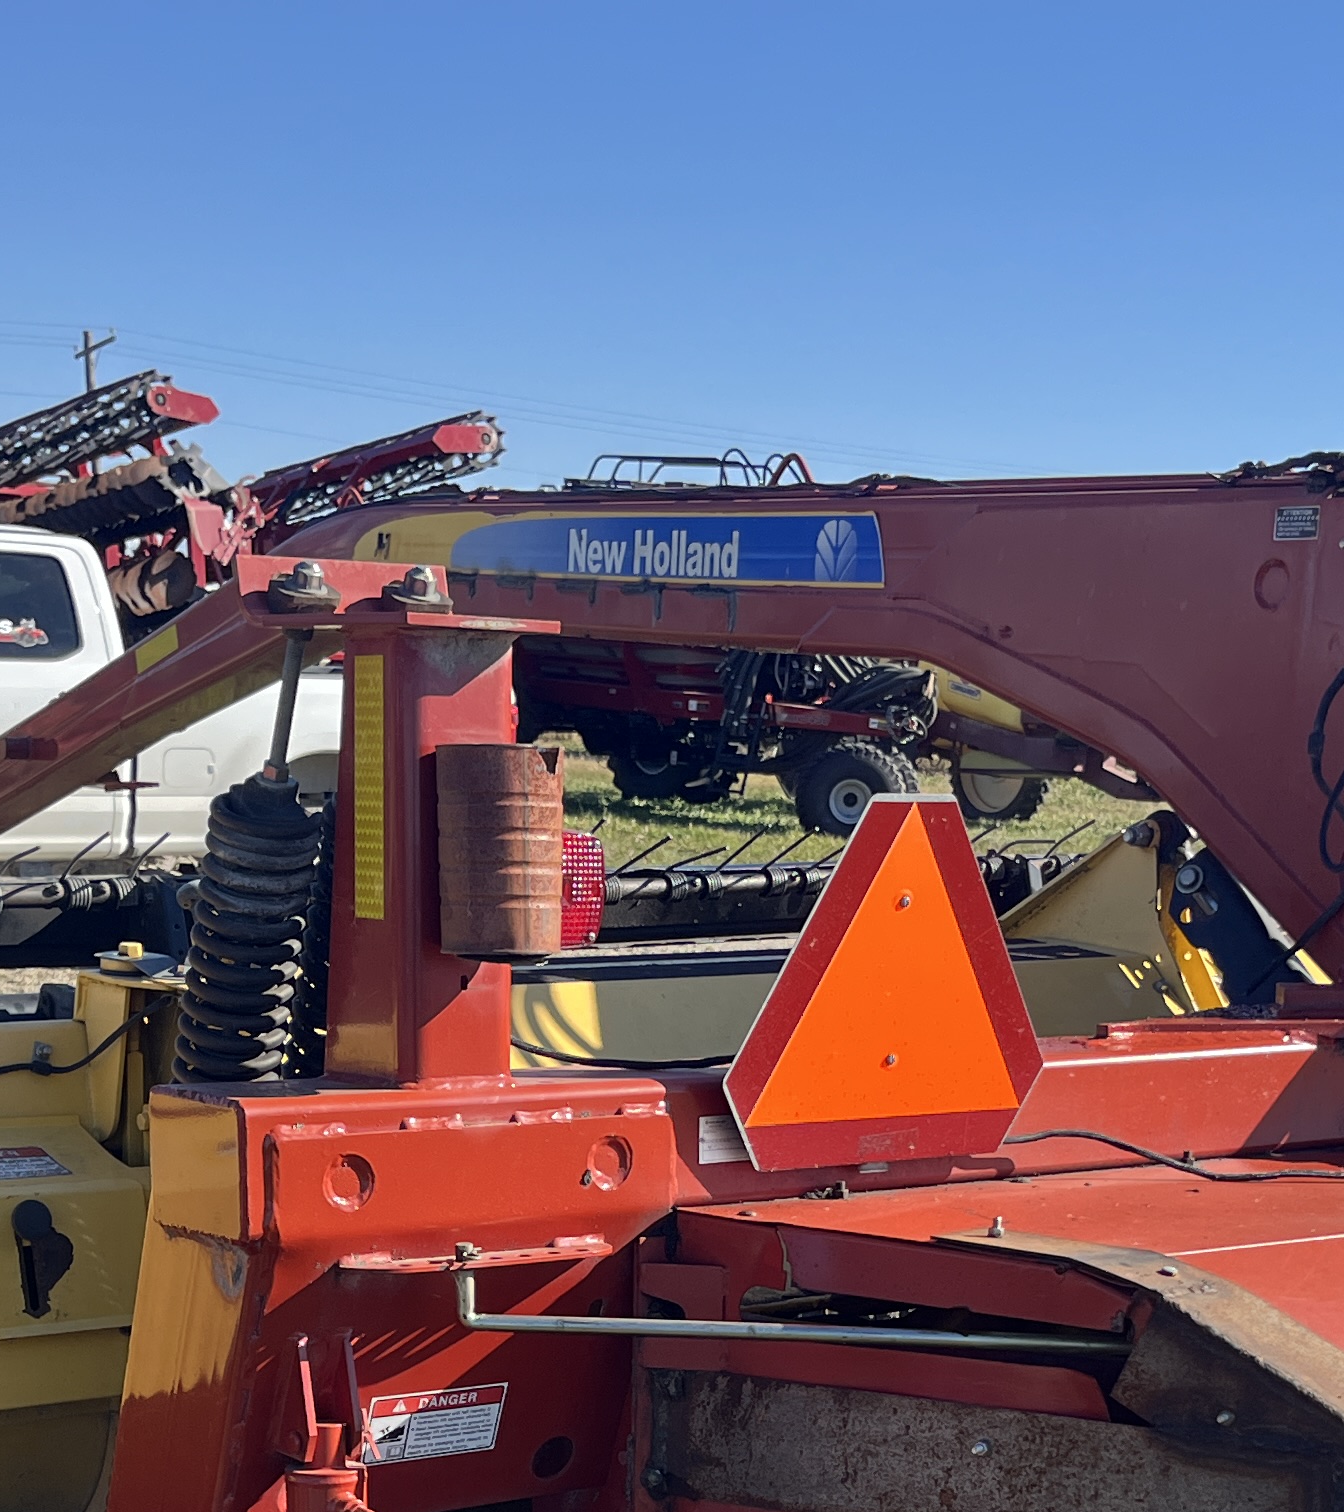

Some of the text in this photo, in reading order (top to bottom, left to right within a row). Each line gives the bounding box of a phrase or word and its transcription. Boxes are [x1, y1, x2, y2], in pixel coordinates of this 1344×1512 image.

[567, 528, 740, 578] New Holland
[417, 1391, 479, 1409] DANGER
